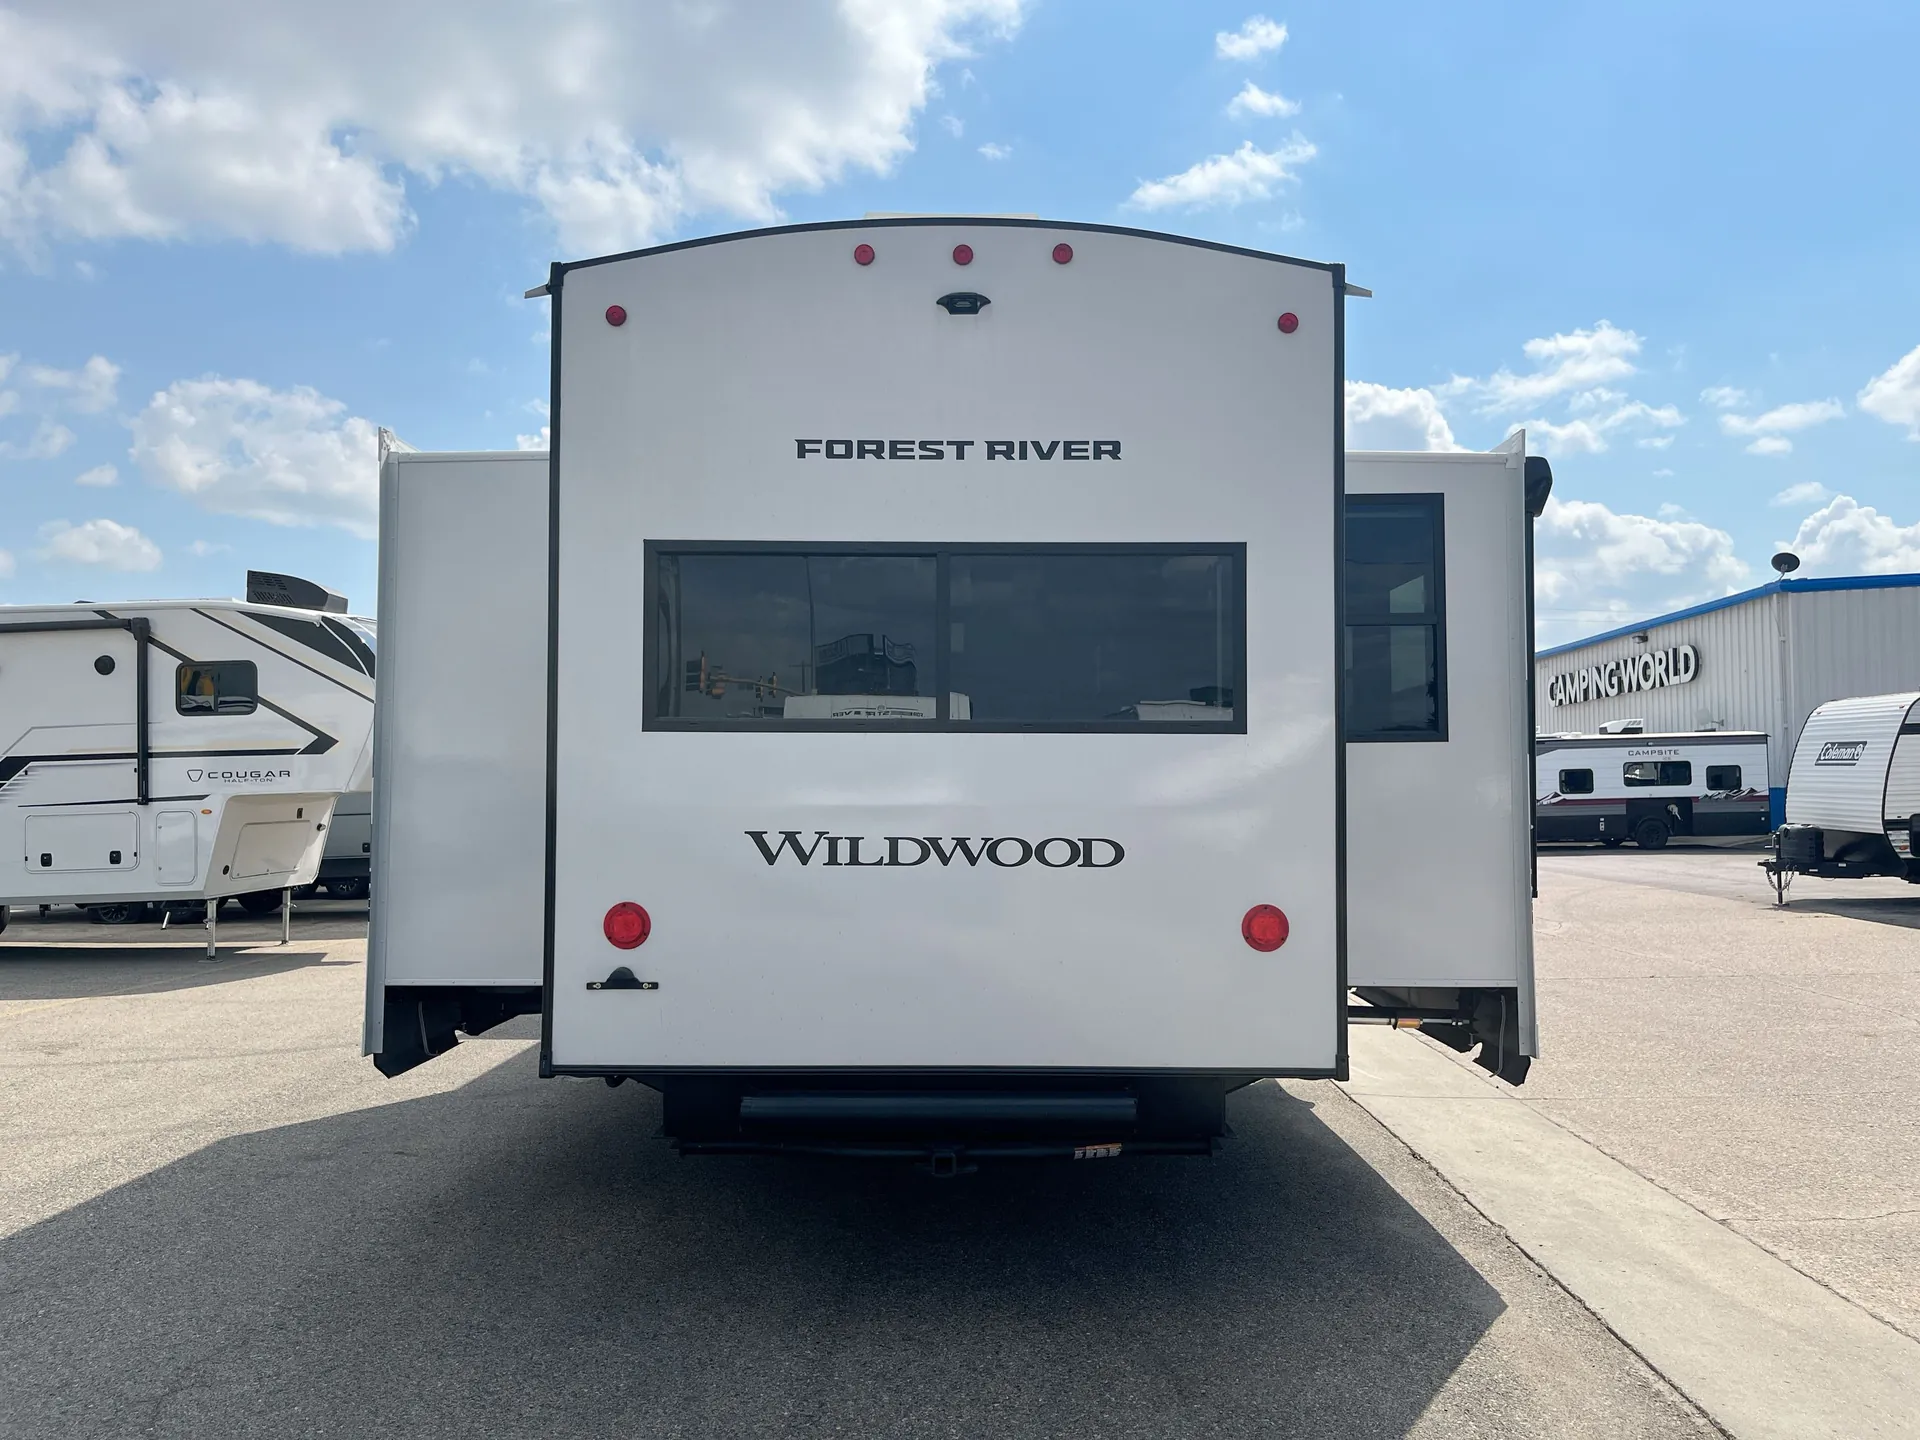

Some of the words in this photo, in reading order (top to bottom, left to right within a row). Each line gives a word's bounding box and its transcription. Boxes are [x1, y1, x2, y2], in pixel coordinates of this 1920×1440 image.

[794, 439, 975, 460] FOREST
[984, 440, 1122, 461] RIVER
[1547, 661, 1619, 707] CAMPING
[1620, 644, 1699, 694] WORLD
[1820, 743, 1856, 760] Coleman
[208, 770, 290, 779] COUGAR
[744, 830, 1126, 868] WILDWOOD
